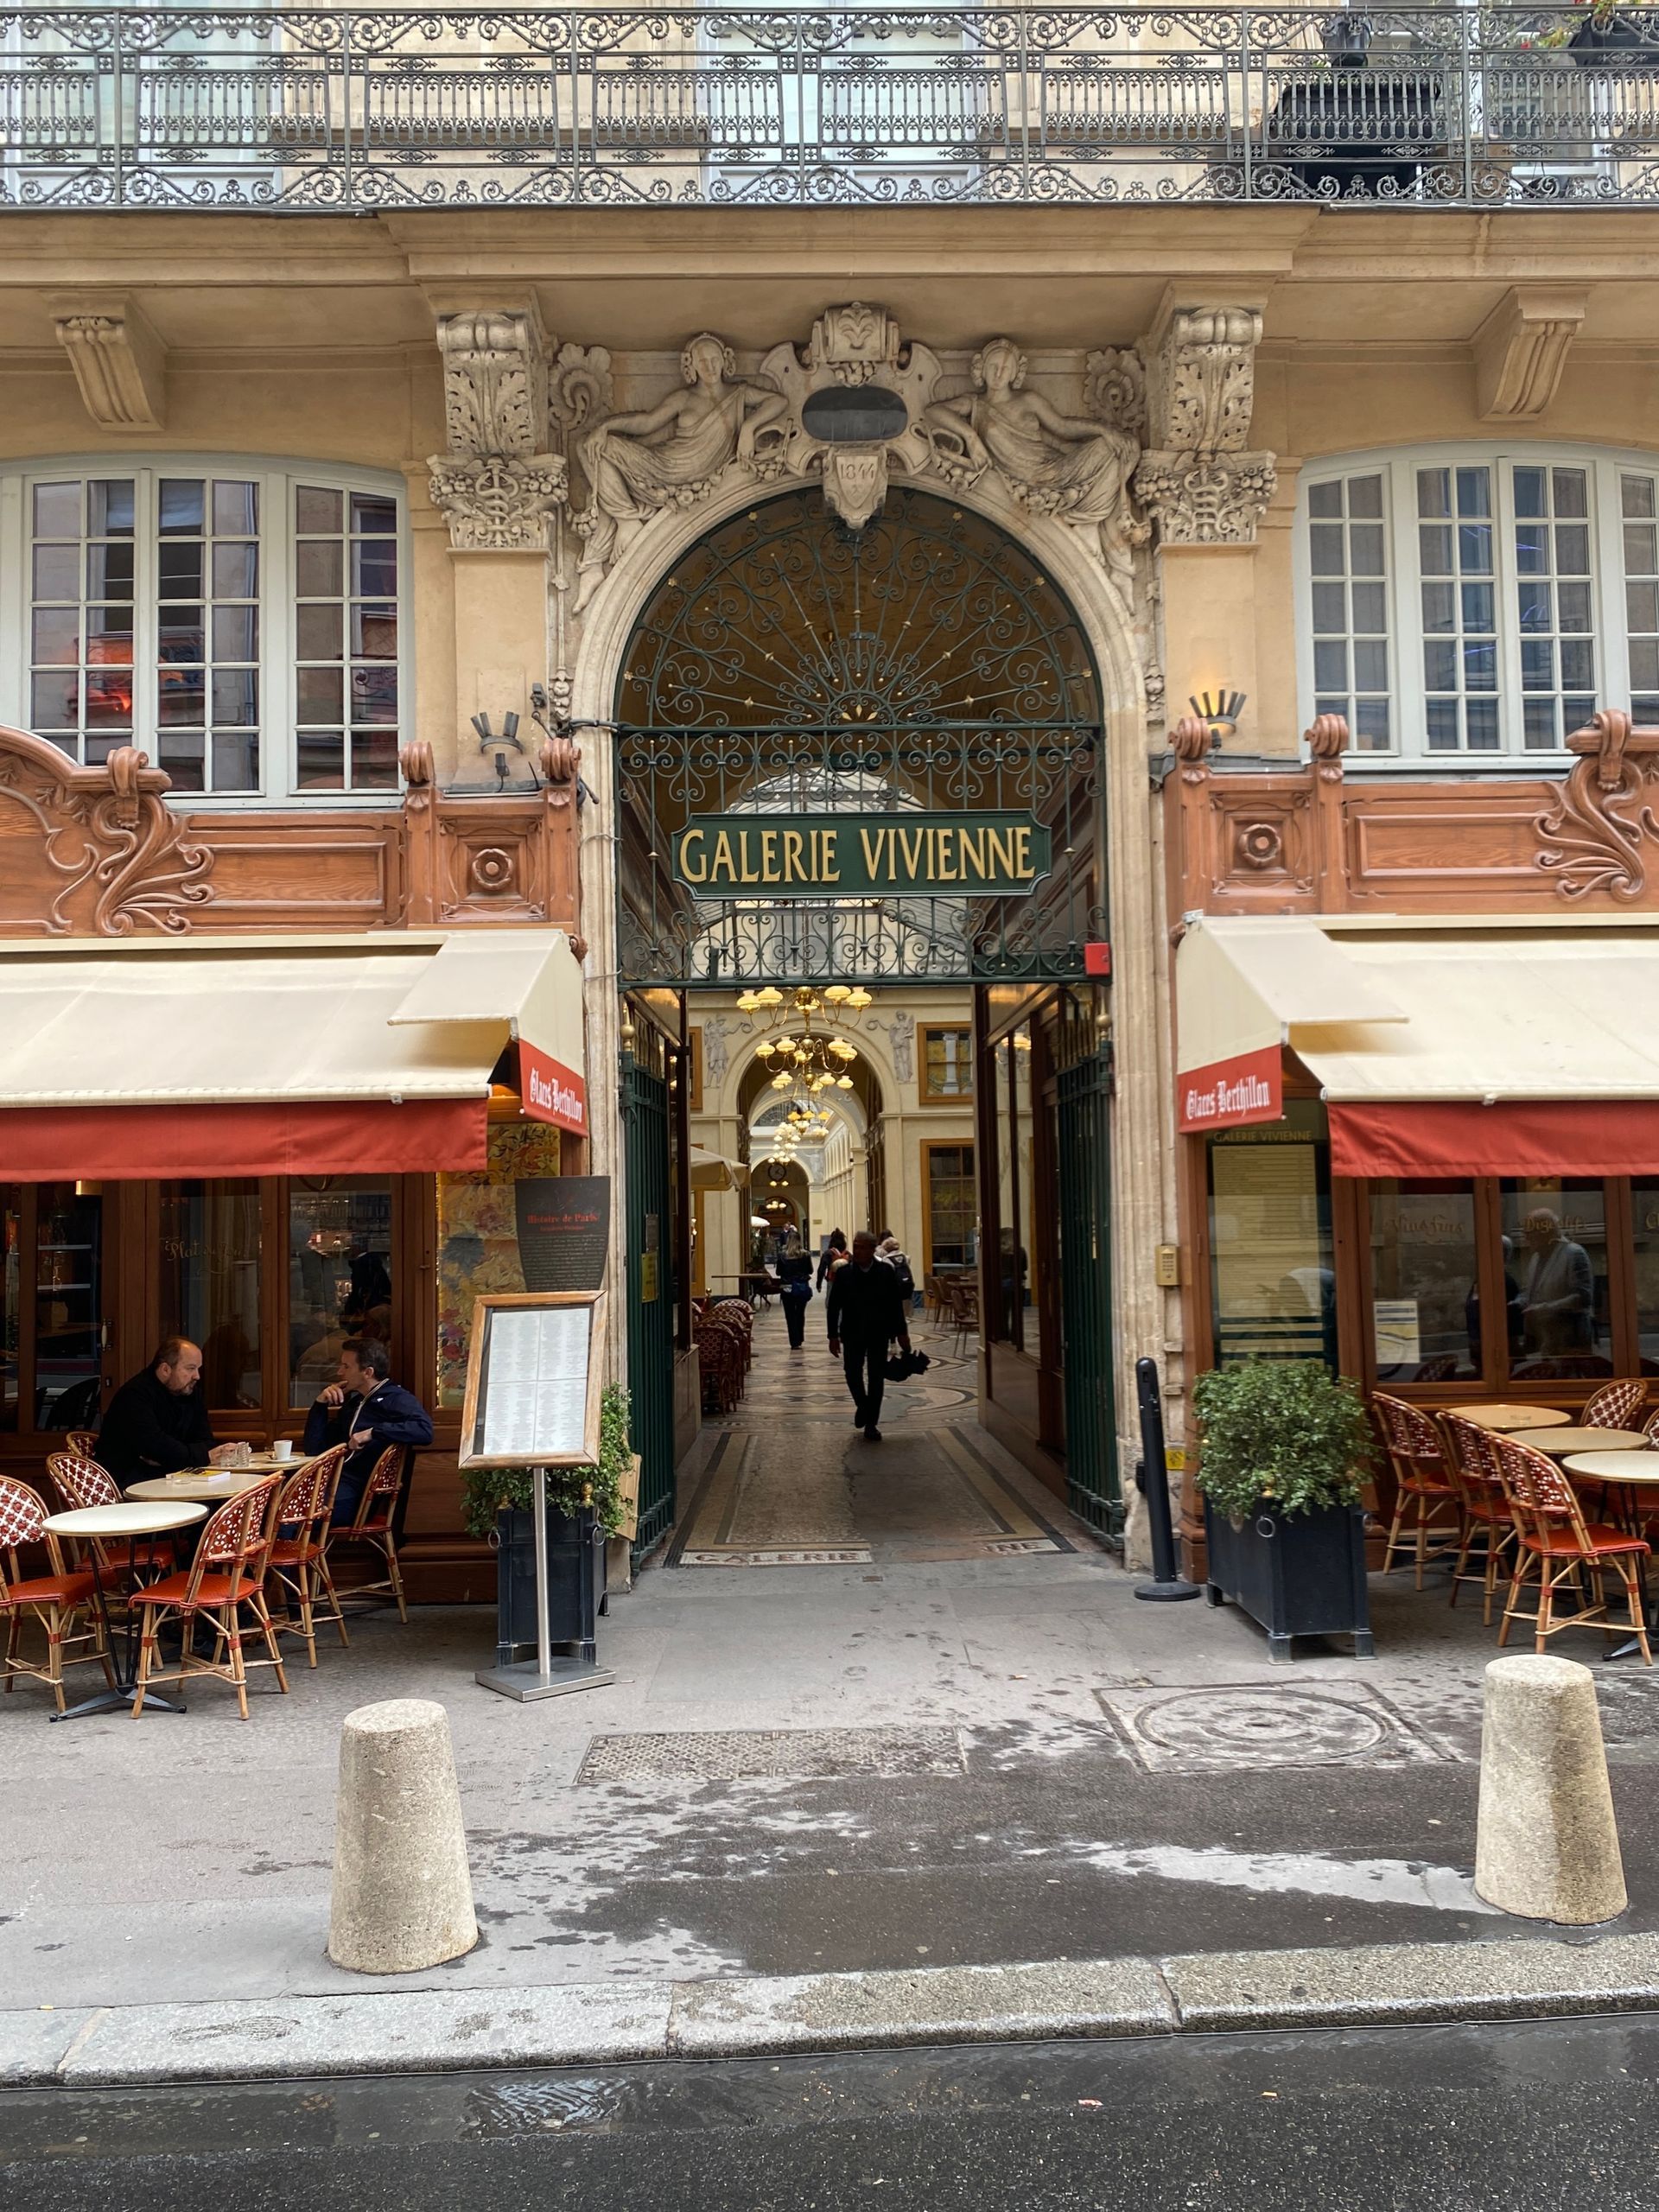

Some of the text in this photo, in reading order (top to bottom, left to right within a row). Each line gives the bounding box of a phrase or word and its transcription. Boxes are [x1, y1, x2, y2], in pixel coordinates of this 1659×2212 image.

[840, 462, 875, 480] 1844
[679, 826, 1036, 883] GALERIE VIVIENNE
[530, 1067, 582, 1124] Glaces Berthillon
[1185, 1075, 1270, 1121] Glaces Berthillon
[1215, 1130, 1312, 1142] GALERIE VIVIENNE
[527, 1211, 598, 1224] Histoire de Paris
